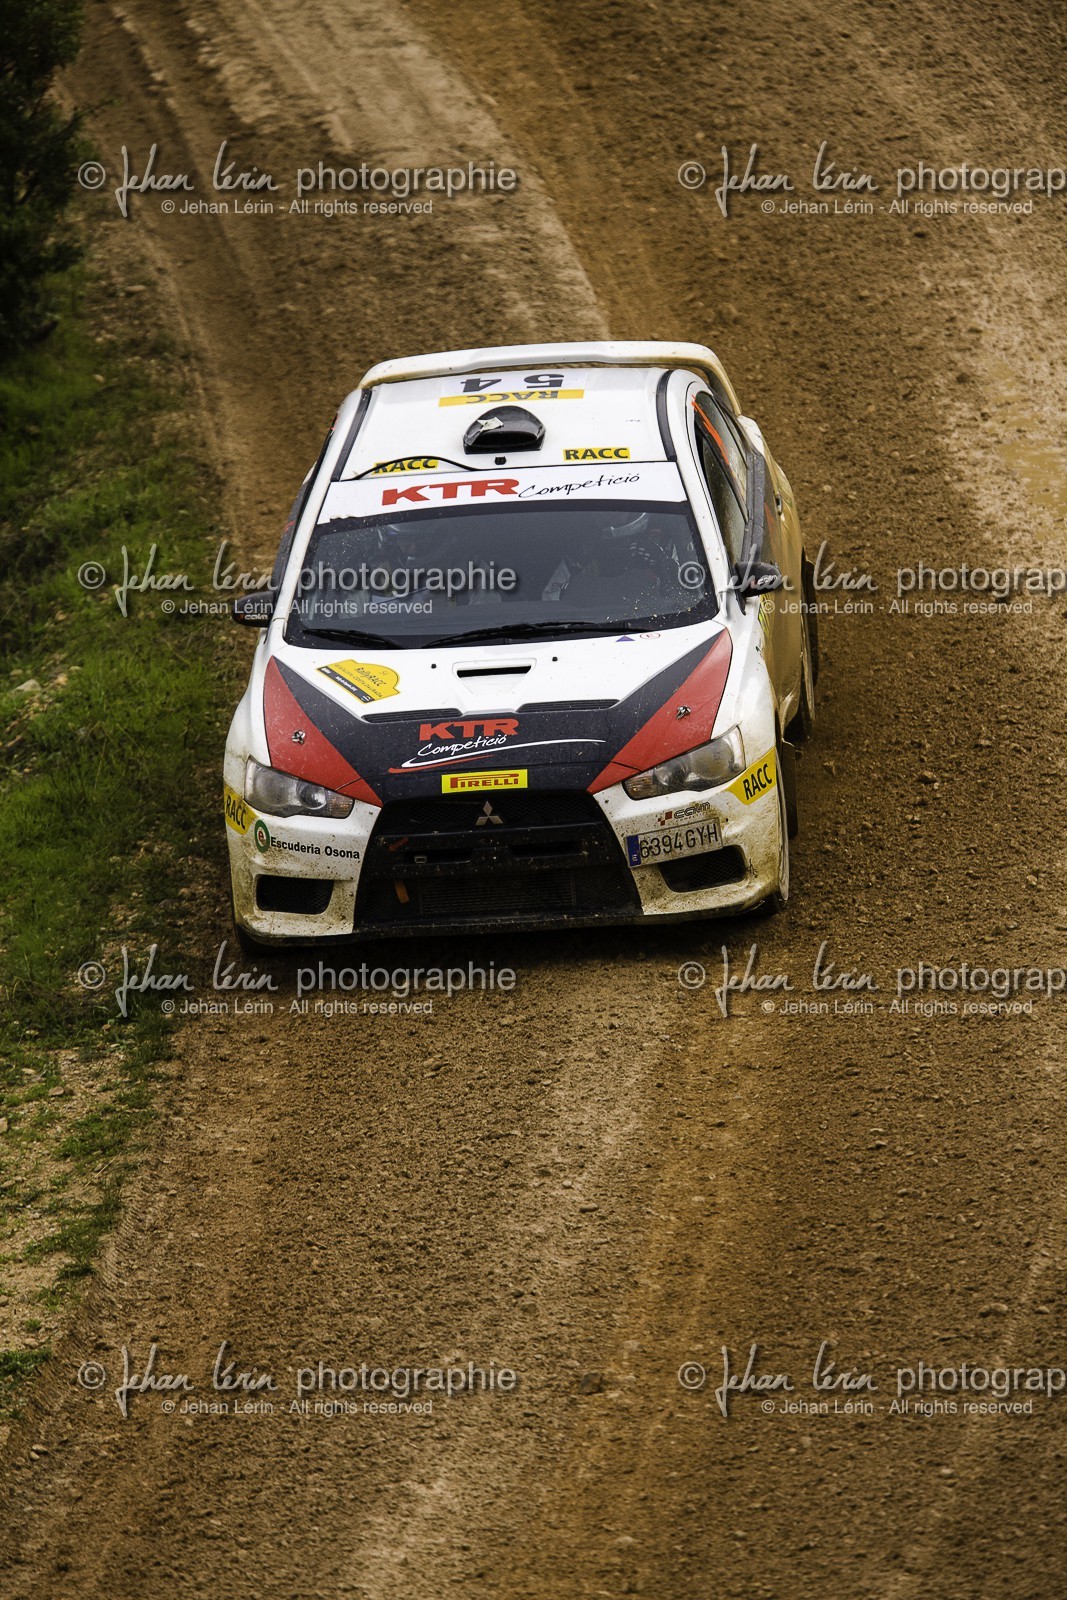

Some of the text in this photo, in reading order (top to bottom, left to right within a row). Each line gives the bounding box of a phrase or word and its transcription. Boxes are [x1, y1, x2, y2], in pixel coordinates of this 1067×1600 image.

[466, 390, 558, 404] RACC
[565, 448, 629, 460] RACC
[382, 472, 640, 506] KTR Competició
[418, 718, 519, 756] KTR Competició
[449, 772, 520, 789] PIRELLI
[743, 763, 773, 801] RACC
[225, 796, 247, 830] RACC
[270, 837, 360, 860] Escuderia Osona
